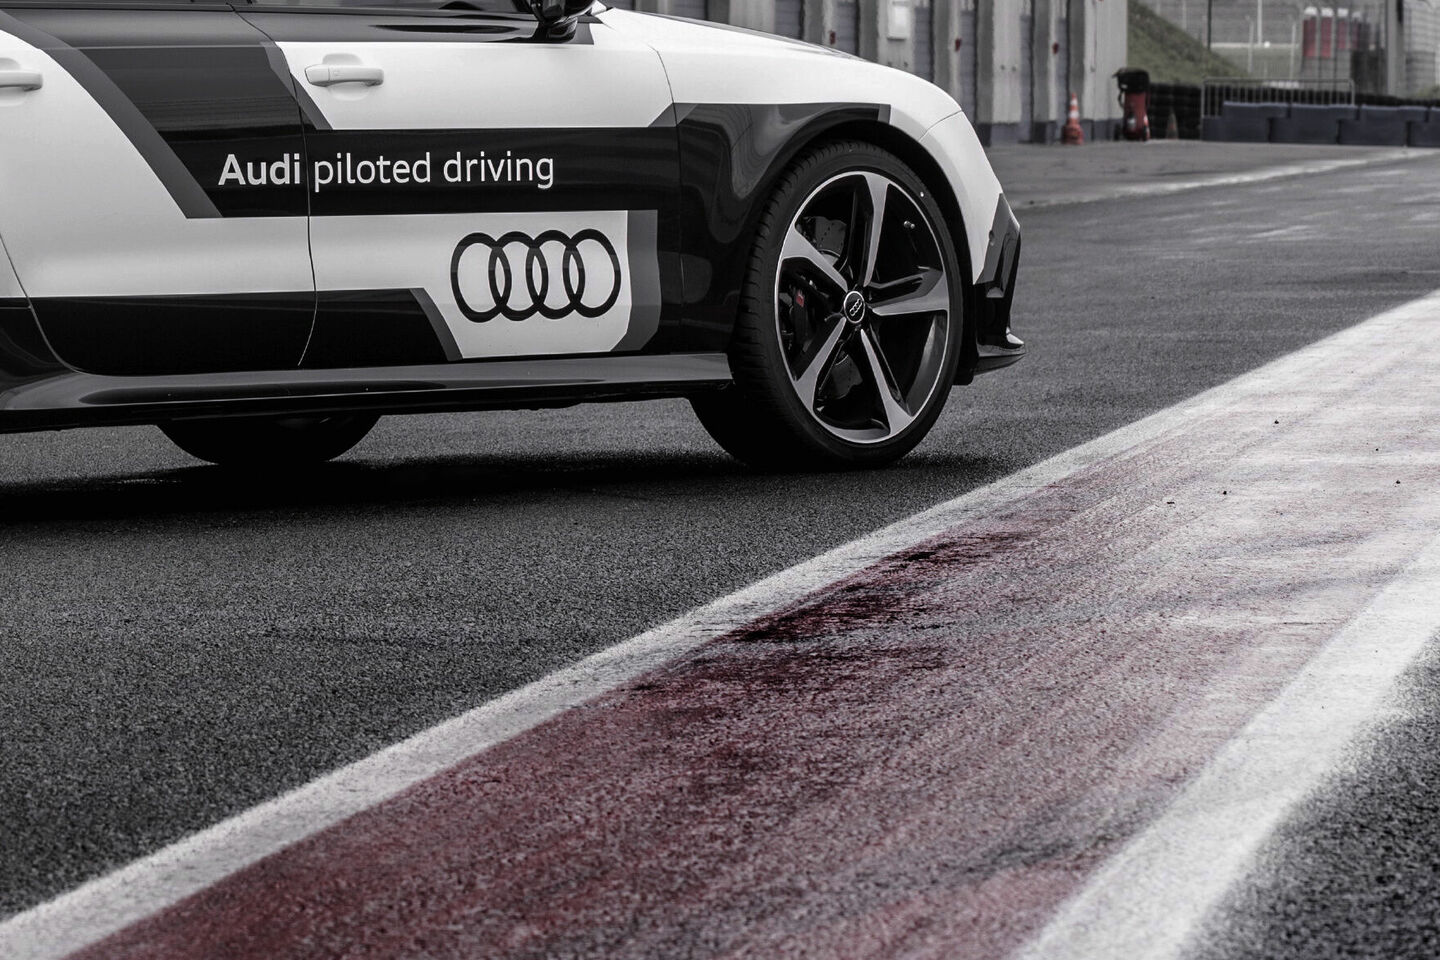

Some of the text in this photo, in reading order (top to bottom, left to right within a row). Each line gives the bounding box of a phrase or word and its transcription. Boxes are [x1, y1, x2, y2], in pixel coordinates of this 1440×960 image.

[218, 150, 554, 192] Audi piloted driving
